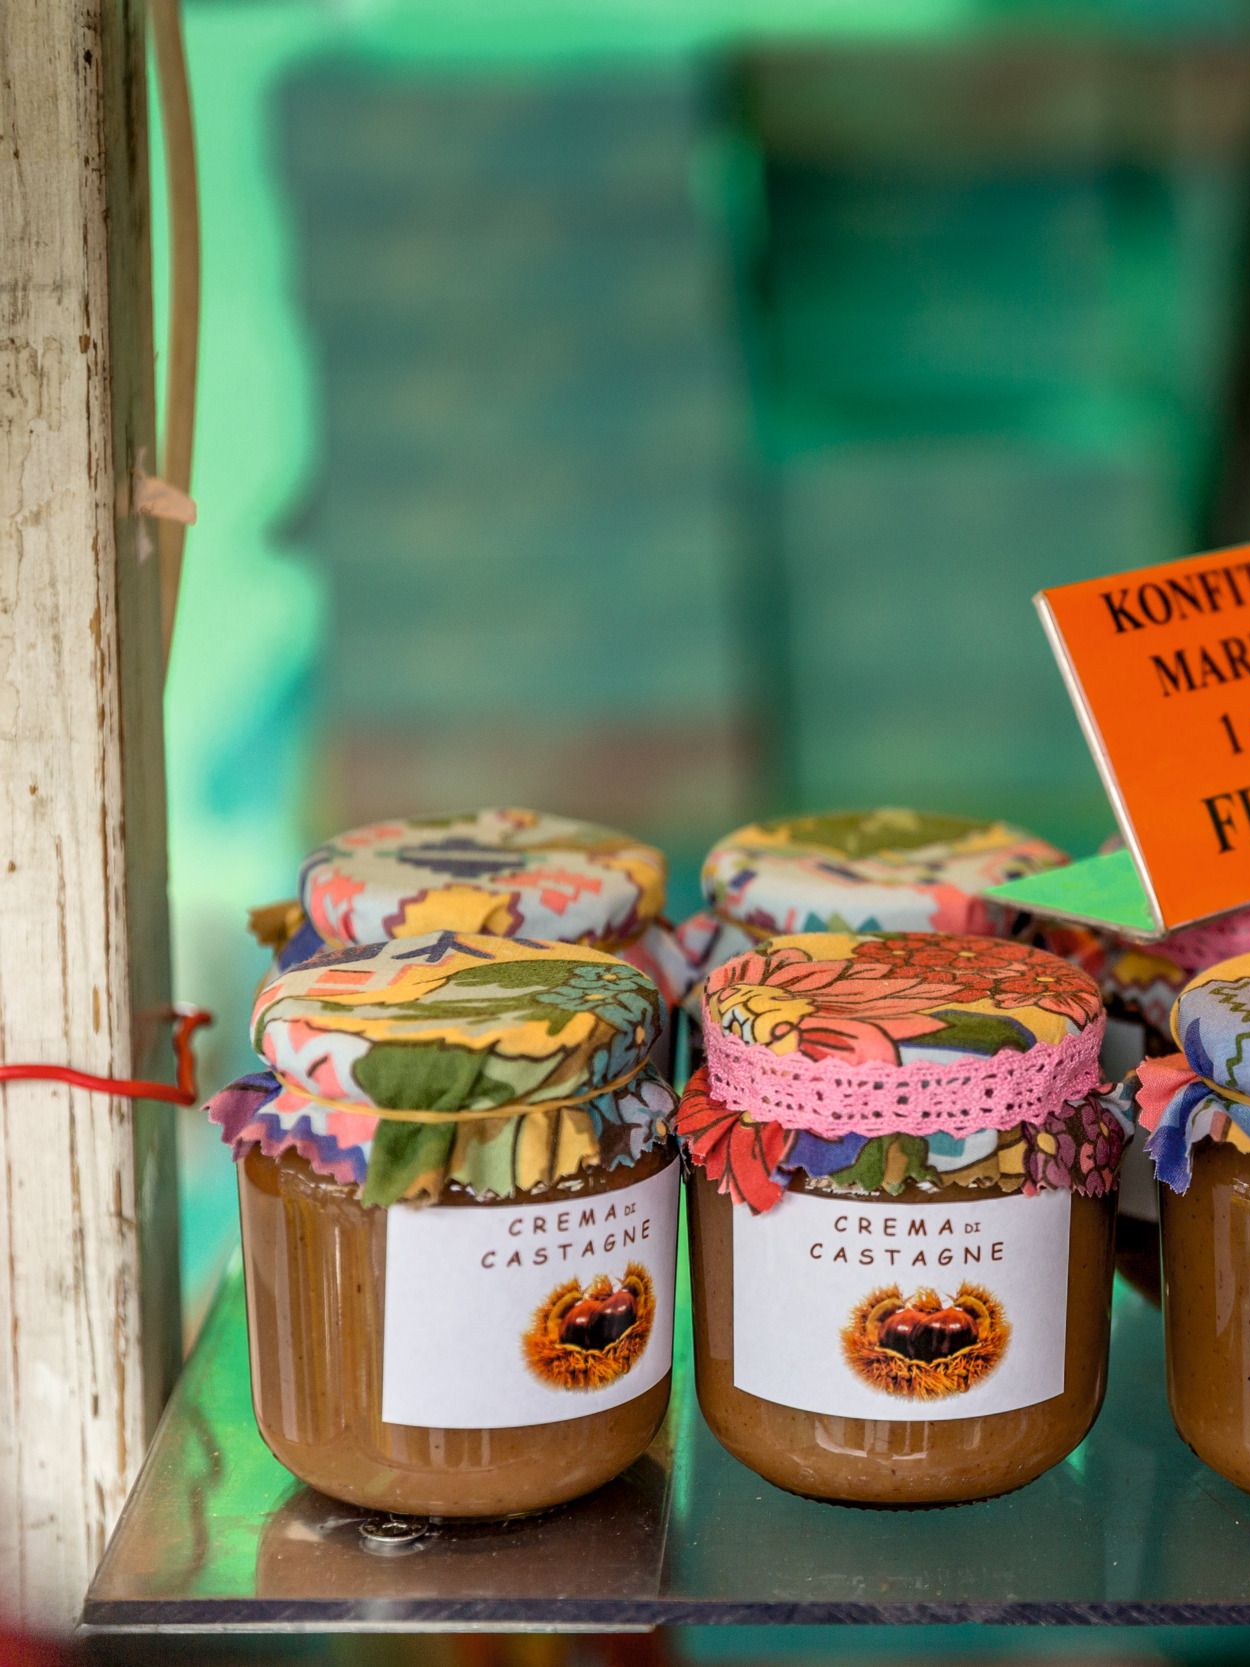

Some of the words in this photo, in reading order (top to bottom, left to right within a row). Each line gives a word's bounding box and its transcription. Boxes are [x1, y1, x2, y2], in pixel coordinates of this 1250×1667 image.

[1219, 713, 1244, 755] 1
[507, 1203, 617, 1237] CREMA
[623, 1202, 637, 1217] DI
[833, 1215, 954, 1237] CREMA
[964, 1222, 982, 1235] DI
[480, 1218, 651, 1268] CASTAGNE
[809, 1241, 1005, 1267] CASTAGNE
